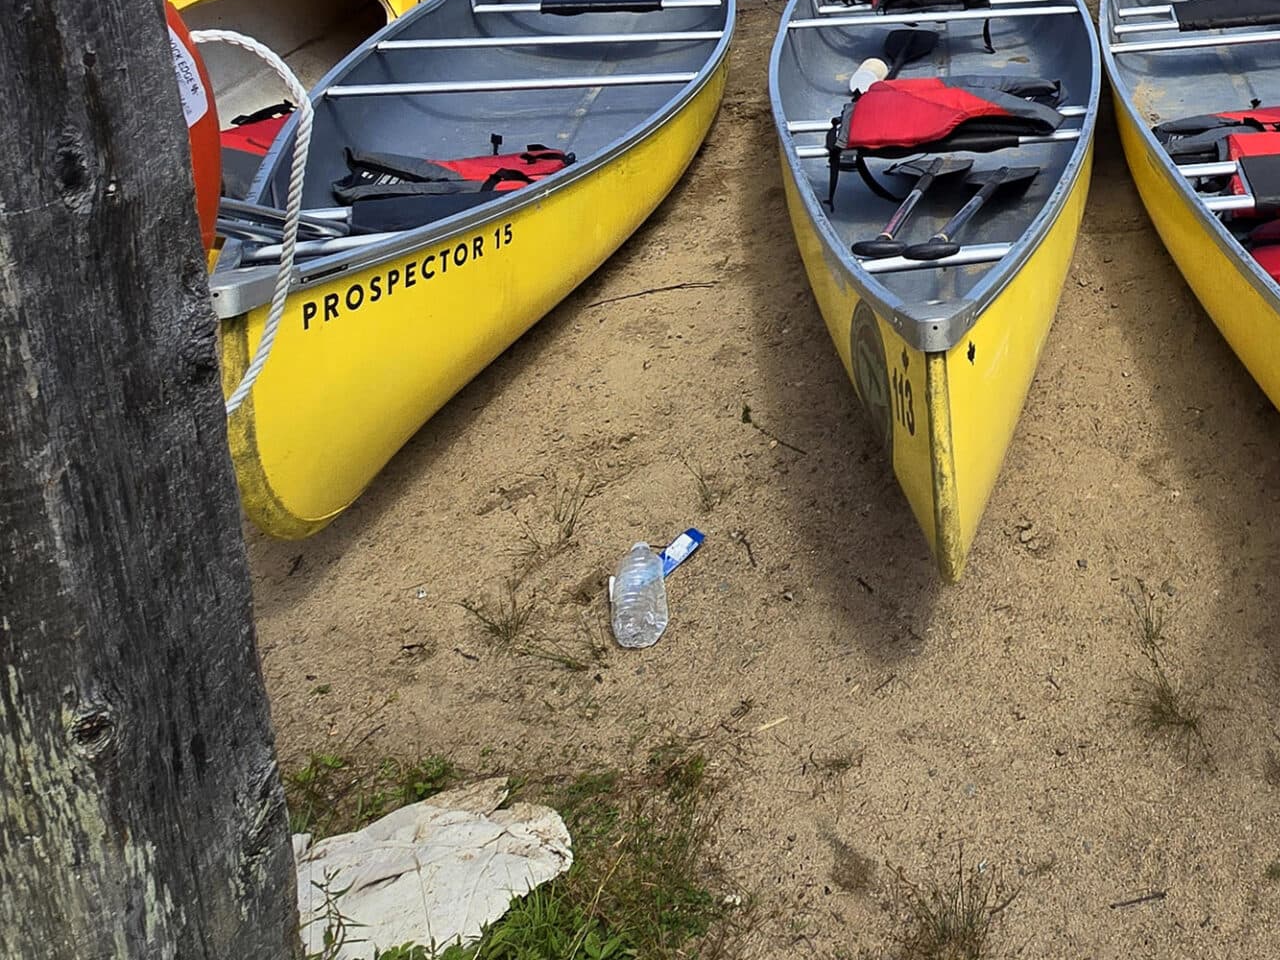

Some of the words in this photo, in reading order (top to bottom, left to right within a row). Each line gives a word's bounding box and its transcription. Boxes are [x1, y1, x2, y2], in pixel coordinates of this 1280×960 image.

[178, 60, 194, 84] EDGE
[302, 235, 484, 330] PROSPECTOR
[493, 223, 514, 249] 15
[892, 367, 915, 436] 113
